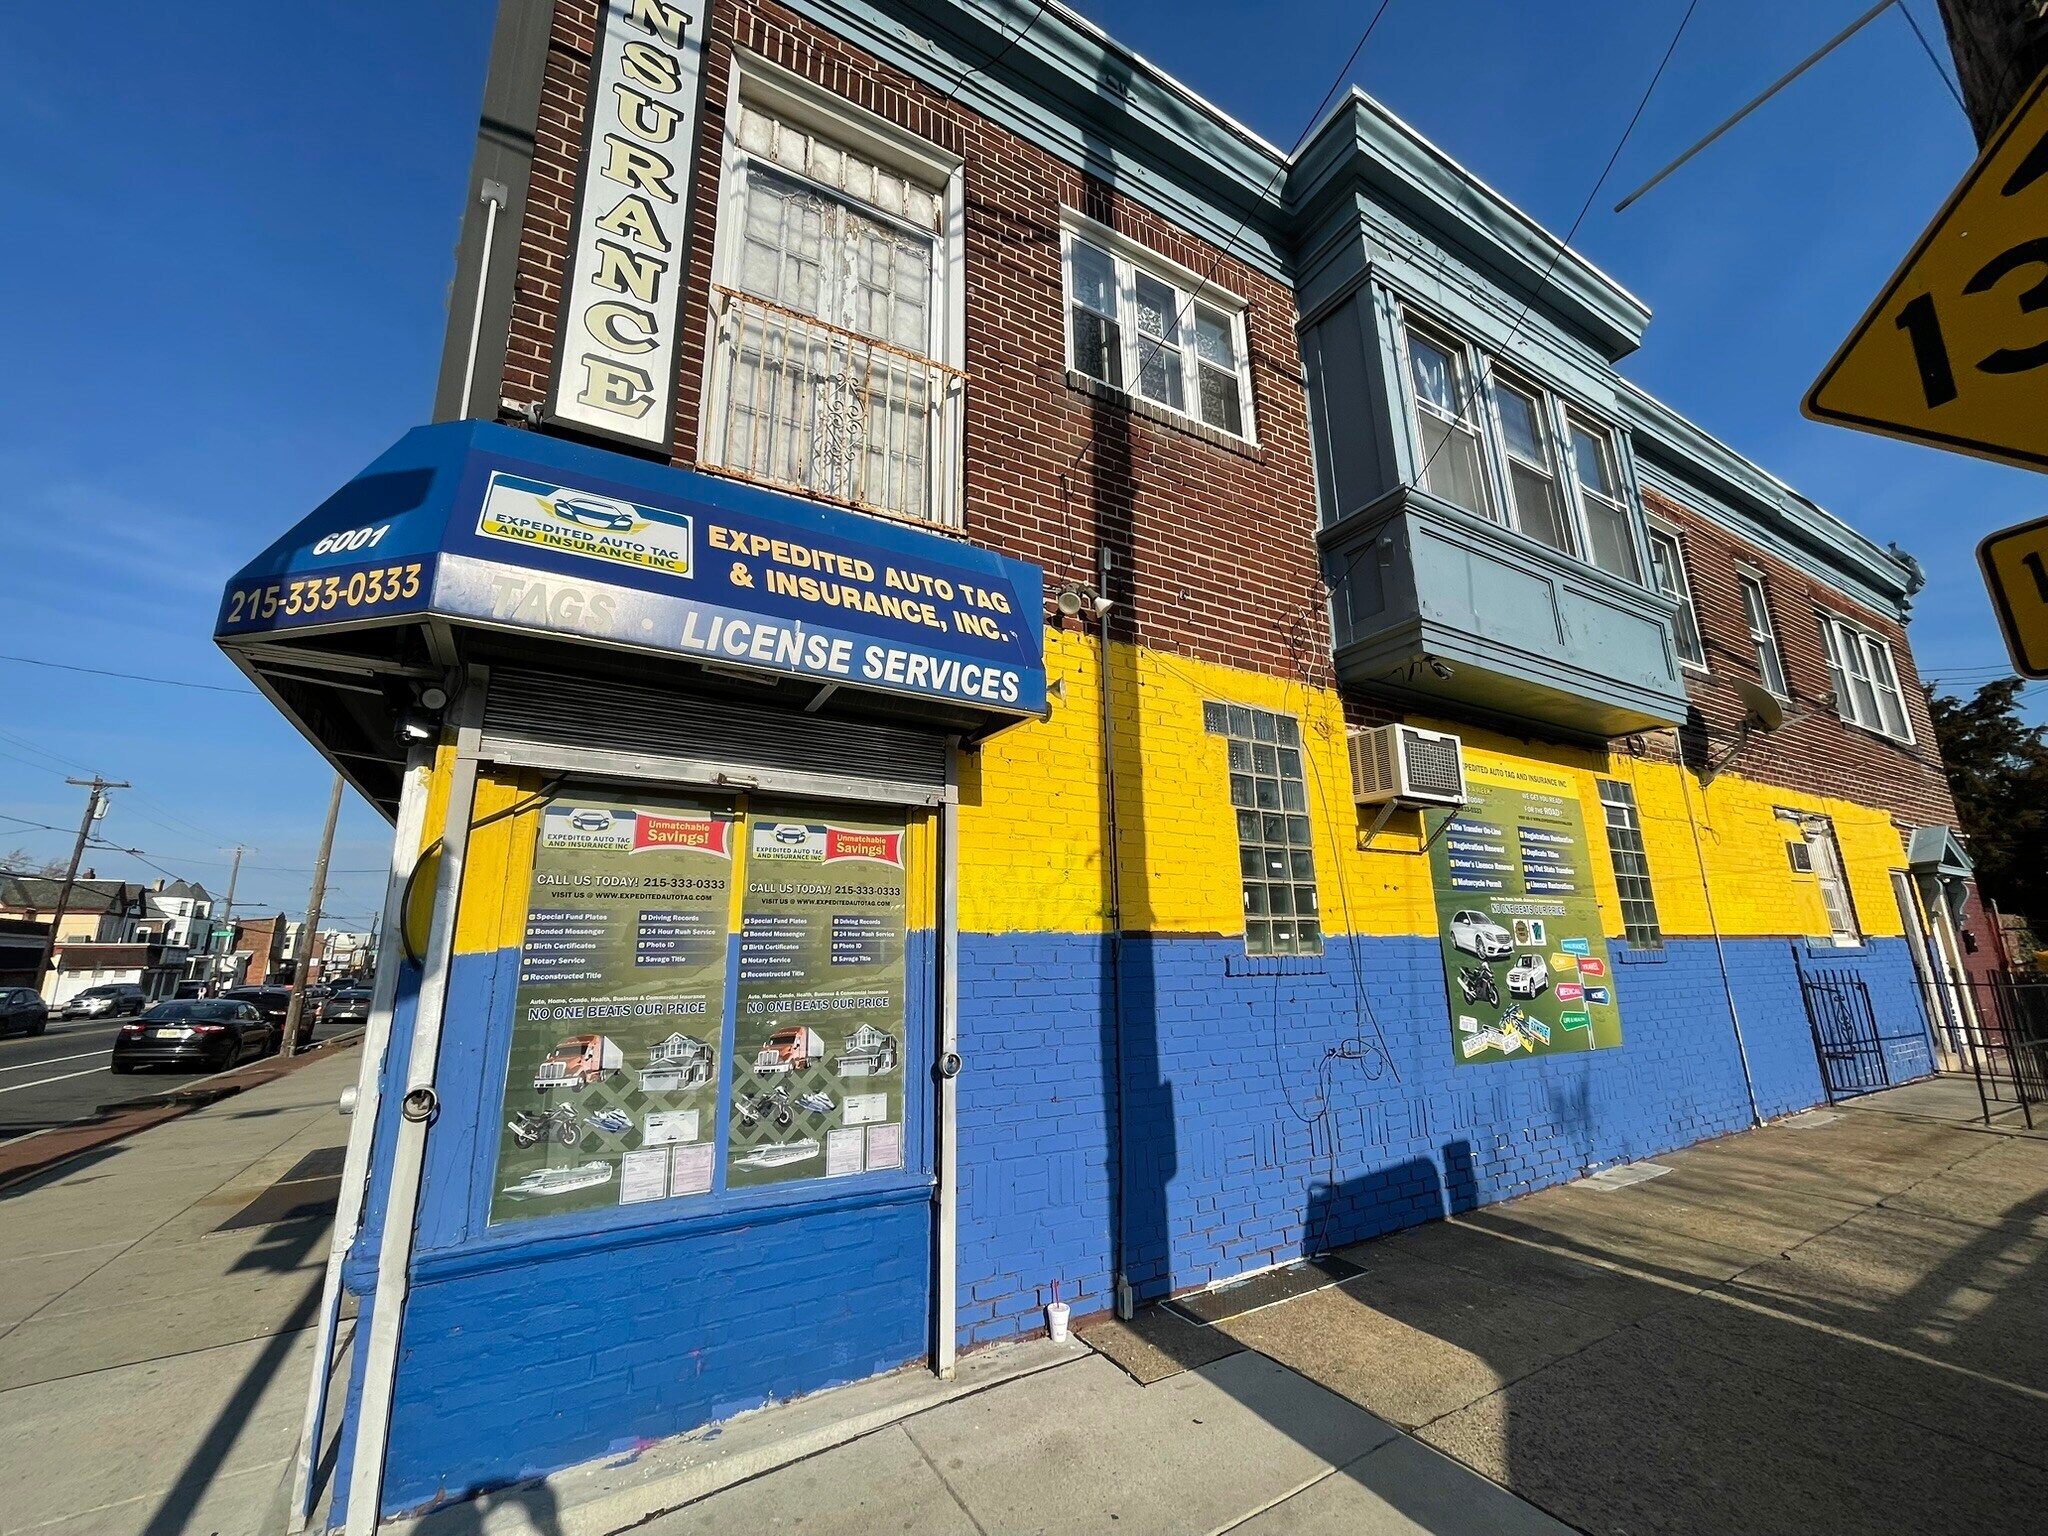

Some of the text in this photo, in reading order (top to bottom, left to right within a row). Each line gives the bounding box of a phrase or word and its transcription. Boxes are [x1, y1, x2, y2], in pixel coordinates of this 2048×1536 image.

[312, 524, 391, 556] 6001
[496, 514, 679, 560] EXPEDITED AUTO TAG
[496, 525, 676, 569] AND INSURANCE INC
[707, 525, 1012, 615] EXPEDITED AUTO TAG
[227, 563, 422, 624] 215-333-0333
[729, 562, 1010, 643] & INSURANCE, INC.
[491, 575, 1021, 703] TAGS LICENSE SERVICES
[1489, 767, 1504, 777] AUTO
[1504, 771, 1515, 779] TAG
[1516, 772, 1528, 781] AND
[1528, 775, 1557, 787] INSURANCE
[648, 820, 710, 832] Unmatchable
[547, 833, 591, 842] EXPEDITED
[568, 841, 613, 849] INSURANCE
[647, 830, 709, 846] Savings!
[836, 834, 886, 844] Unmatchable
[836, 843, 886, 857] Savings!
[536, 874, 726, 890] CALL US TODAY! 215-333-0333
[749, 883, 900, 896] CALL US TODAY! 215-333-0333
[551, 891, 573, 899] VISIT
[595, 892, 712, 901] WWW.EXPEDITEDAUTOTAG.COM
[536, 913, 564, 921] Special
[1491, 903, 1500, 914] NO
[1501, 904, 1514, 914] ONE
[1514, 904, 1533, 915] BEATS
[531, 958, 557, 966] Notary
[528, 1002, 706, 1021] NO ONE BEATS OUR PRICE
[747, 997, 889, 1014] NO ONE BEATS OUR PRICE
